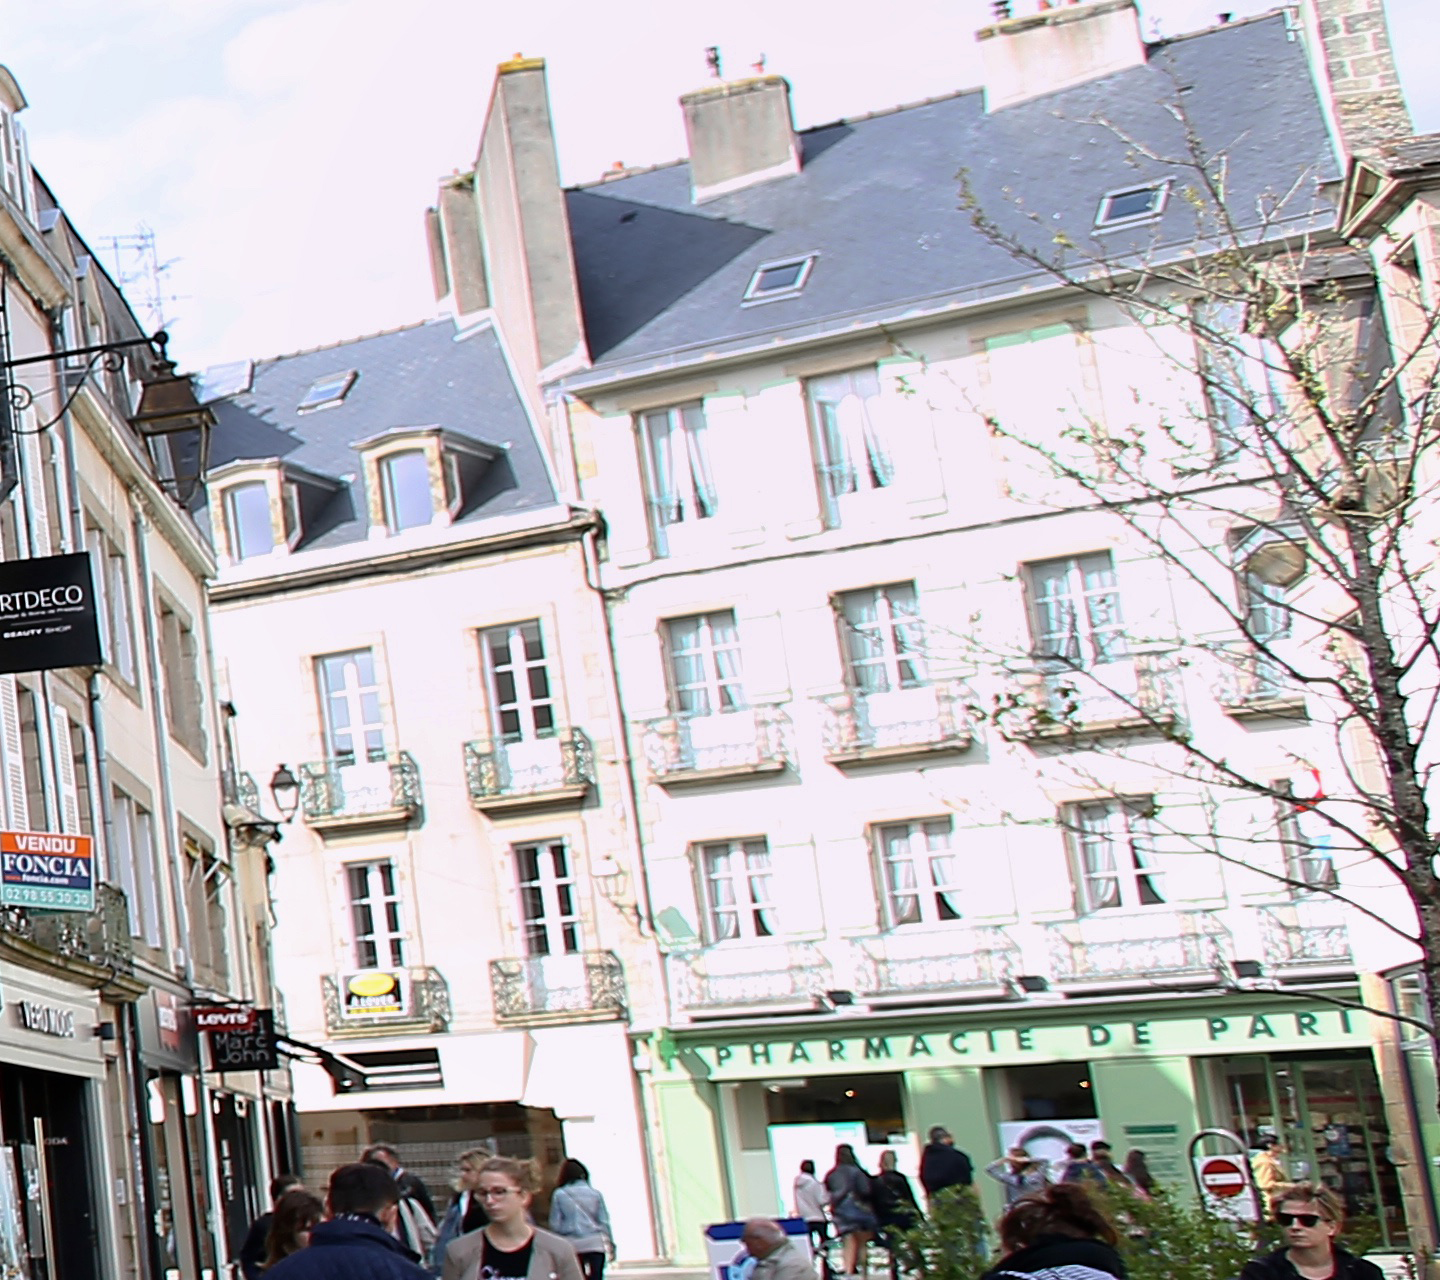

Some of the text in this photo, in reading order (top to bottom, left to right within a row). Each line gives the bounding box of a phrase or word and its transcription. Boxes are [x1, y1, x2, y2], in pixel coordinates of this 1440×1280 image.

[3, 628, 42, 639] BEAUTY
[15, 835, 76, 854] VENDU
[3, 854, 89, 877] FONCIA
[6, 888, 20, 900] 02
[215, 1032, 267, 1050] Marc
[718, 1029, 1034, 1066] PHARMACIE
[1087, 1021, 1151, 1047] DE
[219, 1047, 269, 1063] John
